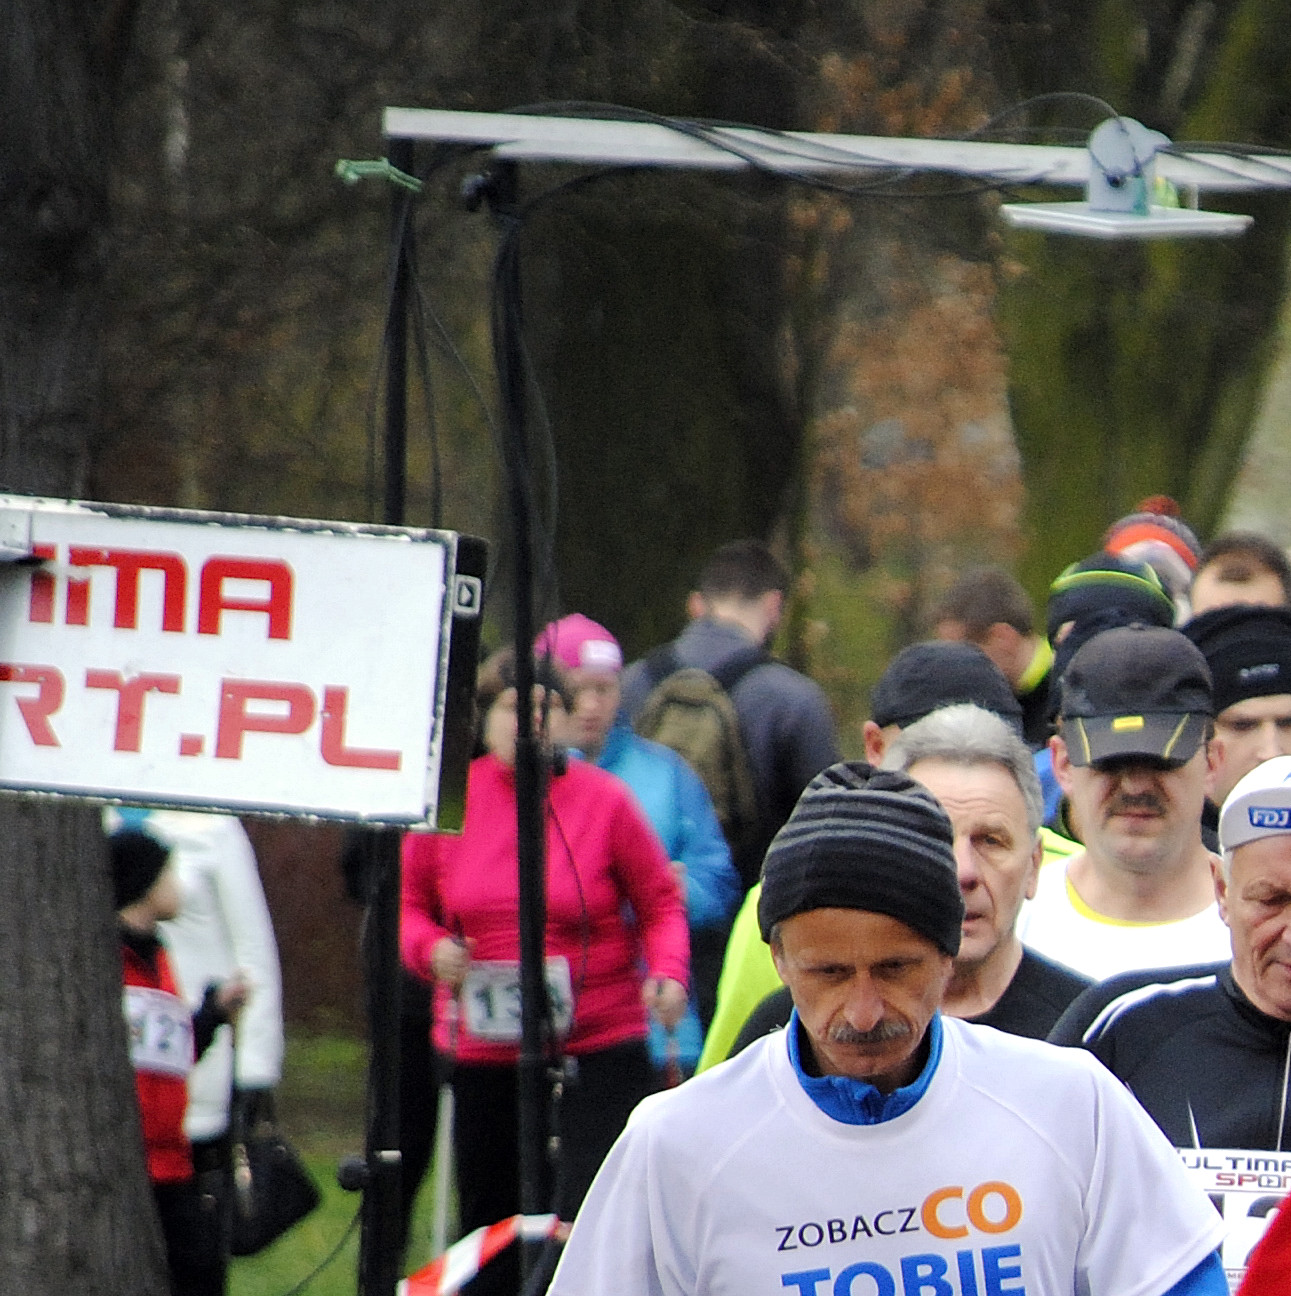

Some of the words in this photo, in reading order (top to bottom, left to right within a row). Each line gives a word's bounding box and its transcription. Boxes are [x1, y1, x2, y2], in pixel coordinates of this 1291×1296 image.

[1253, 810, 1290, 827] FDJ
[775, 1207, 920, 1251] ZOBACZ
[921, 1180, 1023, 1239] CO
